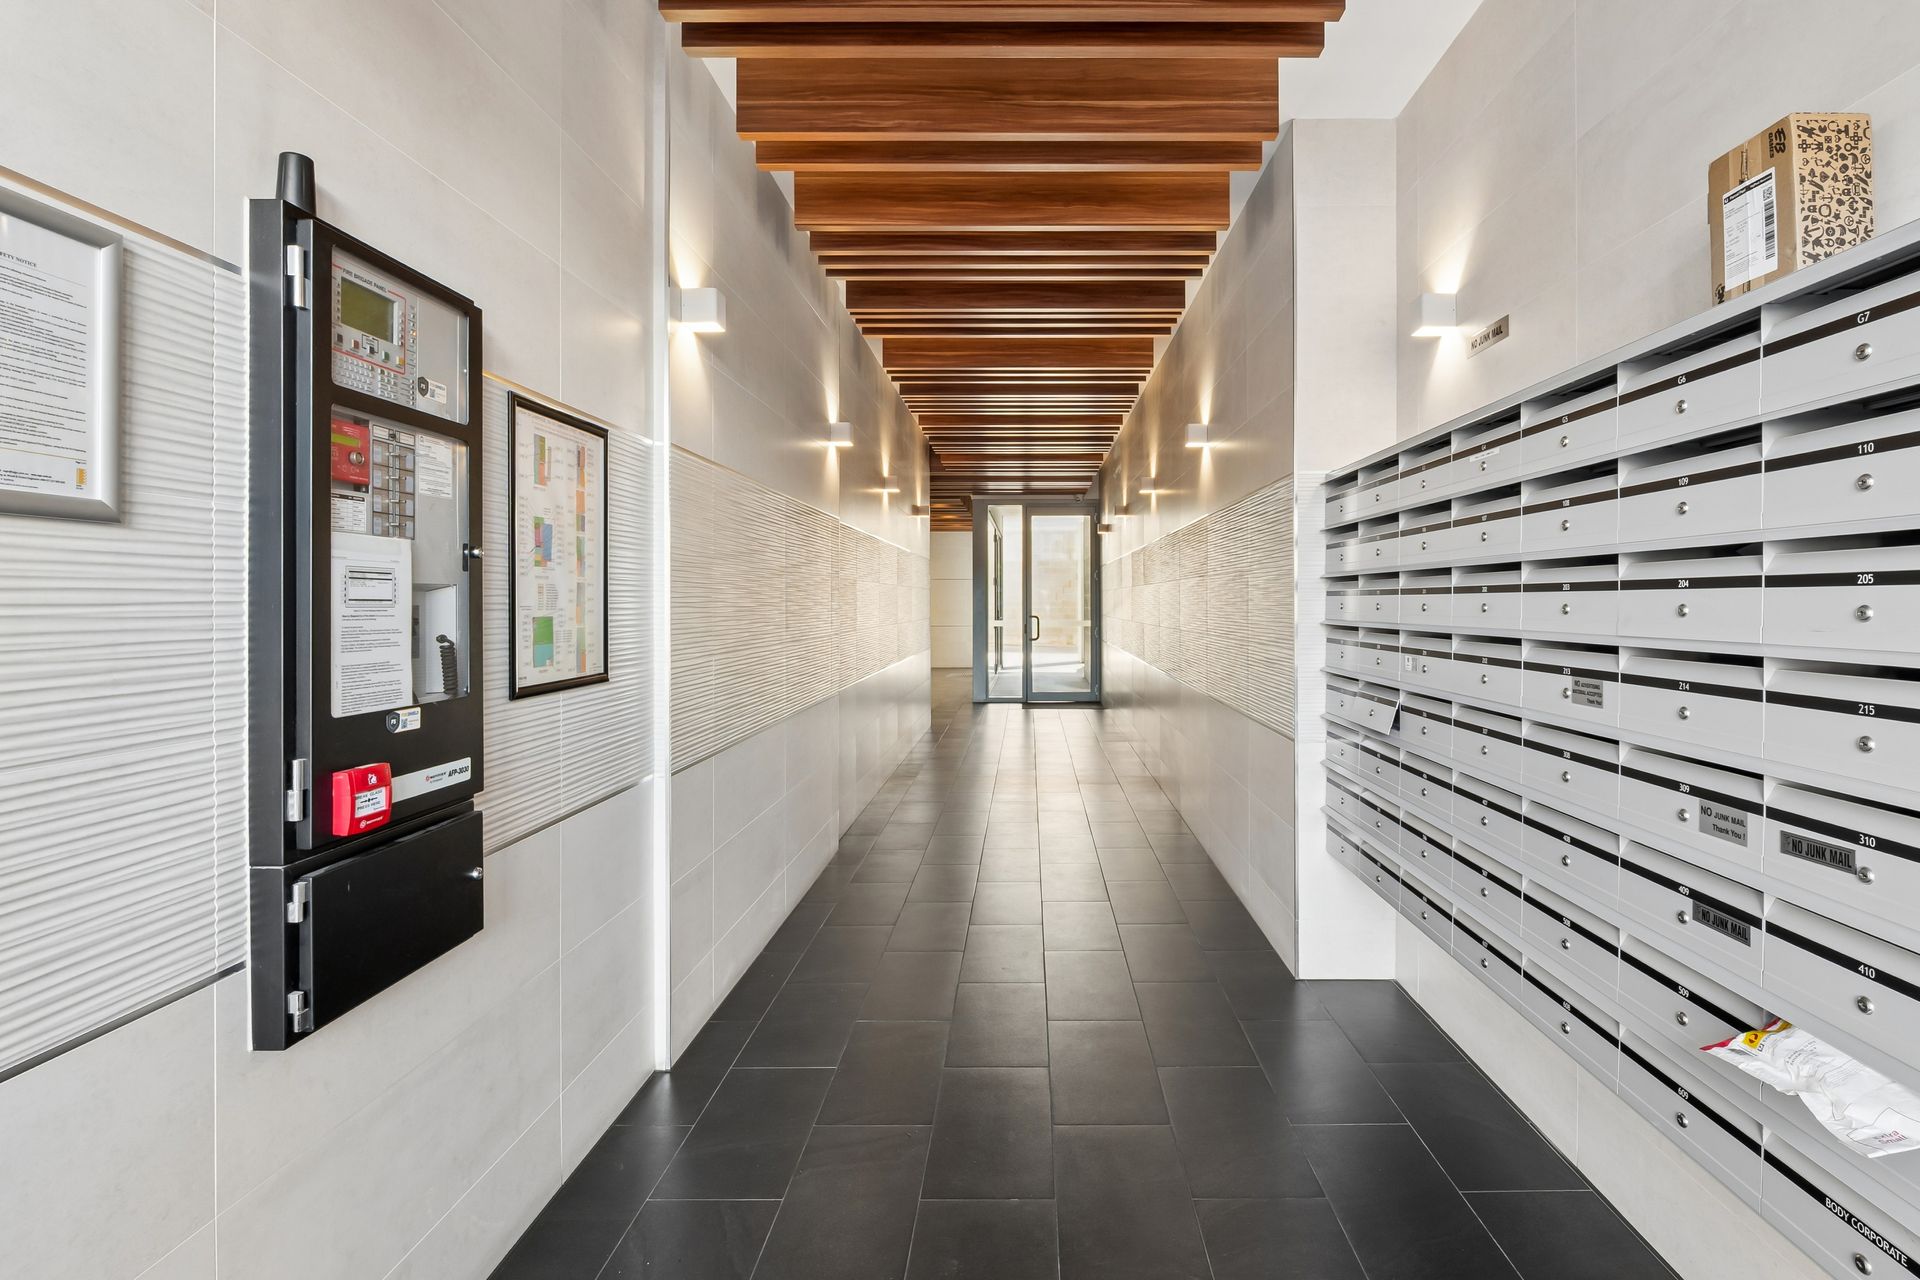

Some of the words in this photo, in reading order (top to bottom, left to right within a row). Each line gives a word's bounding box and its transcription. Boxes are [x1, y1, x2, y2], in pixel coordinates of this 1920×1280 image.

[1774, 128, 1786, 153] EB
[353, 273, 373, 287] BRIGADE
[1857, 311, 1870, 324] G7
[1677, 376, 1686, 384] G6
[1858, 442, 1874, 454] 110
[1678, 477, 1689, 486] 109
[1678, 579, 1689, 588] 204
[1857, 573, 1874, 585] 205
[1679, 682, 1690, 691] 214
[1858, 704, 1875, 716] 215
[1679, 783, 1690, 793] 309
[1701, 805, 1712, 817] NO
[1714, 812, 1730, 823] JUNK
[1731, 817, 1746, 828] MAIL
[1712, 824, 1730, 835] Thank
[1731, 830, 1741, 840] You
[1858, 834, 1875, 848] 310
[1791, 839, 1803, 855] NO
[1805, 843, 1827, 861] JUNK
[1830, 849, 1852, 869] MAIL
[1679, 886, 1690, 896] 409
[1702, 908, 1711, 923] NO
[1712, 914, 1729, 932] JUNK
[1731, 921, 1748, 941] MAIL
[1858, 964, 1875, 979] 410
[1678, 986, 1690, 998] 509
[1678, 1087, 1689, 1099] 609
[1825, 1197, 1850, 1222] BODY
[1851, 1218, 1908, 1268] CORPORATE
